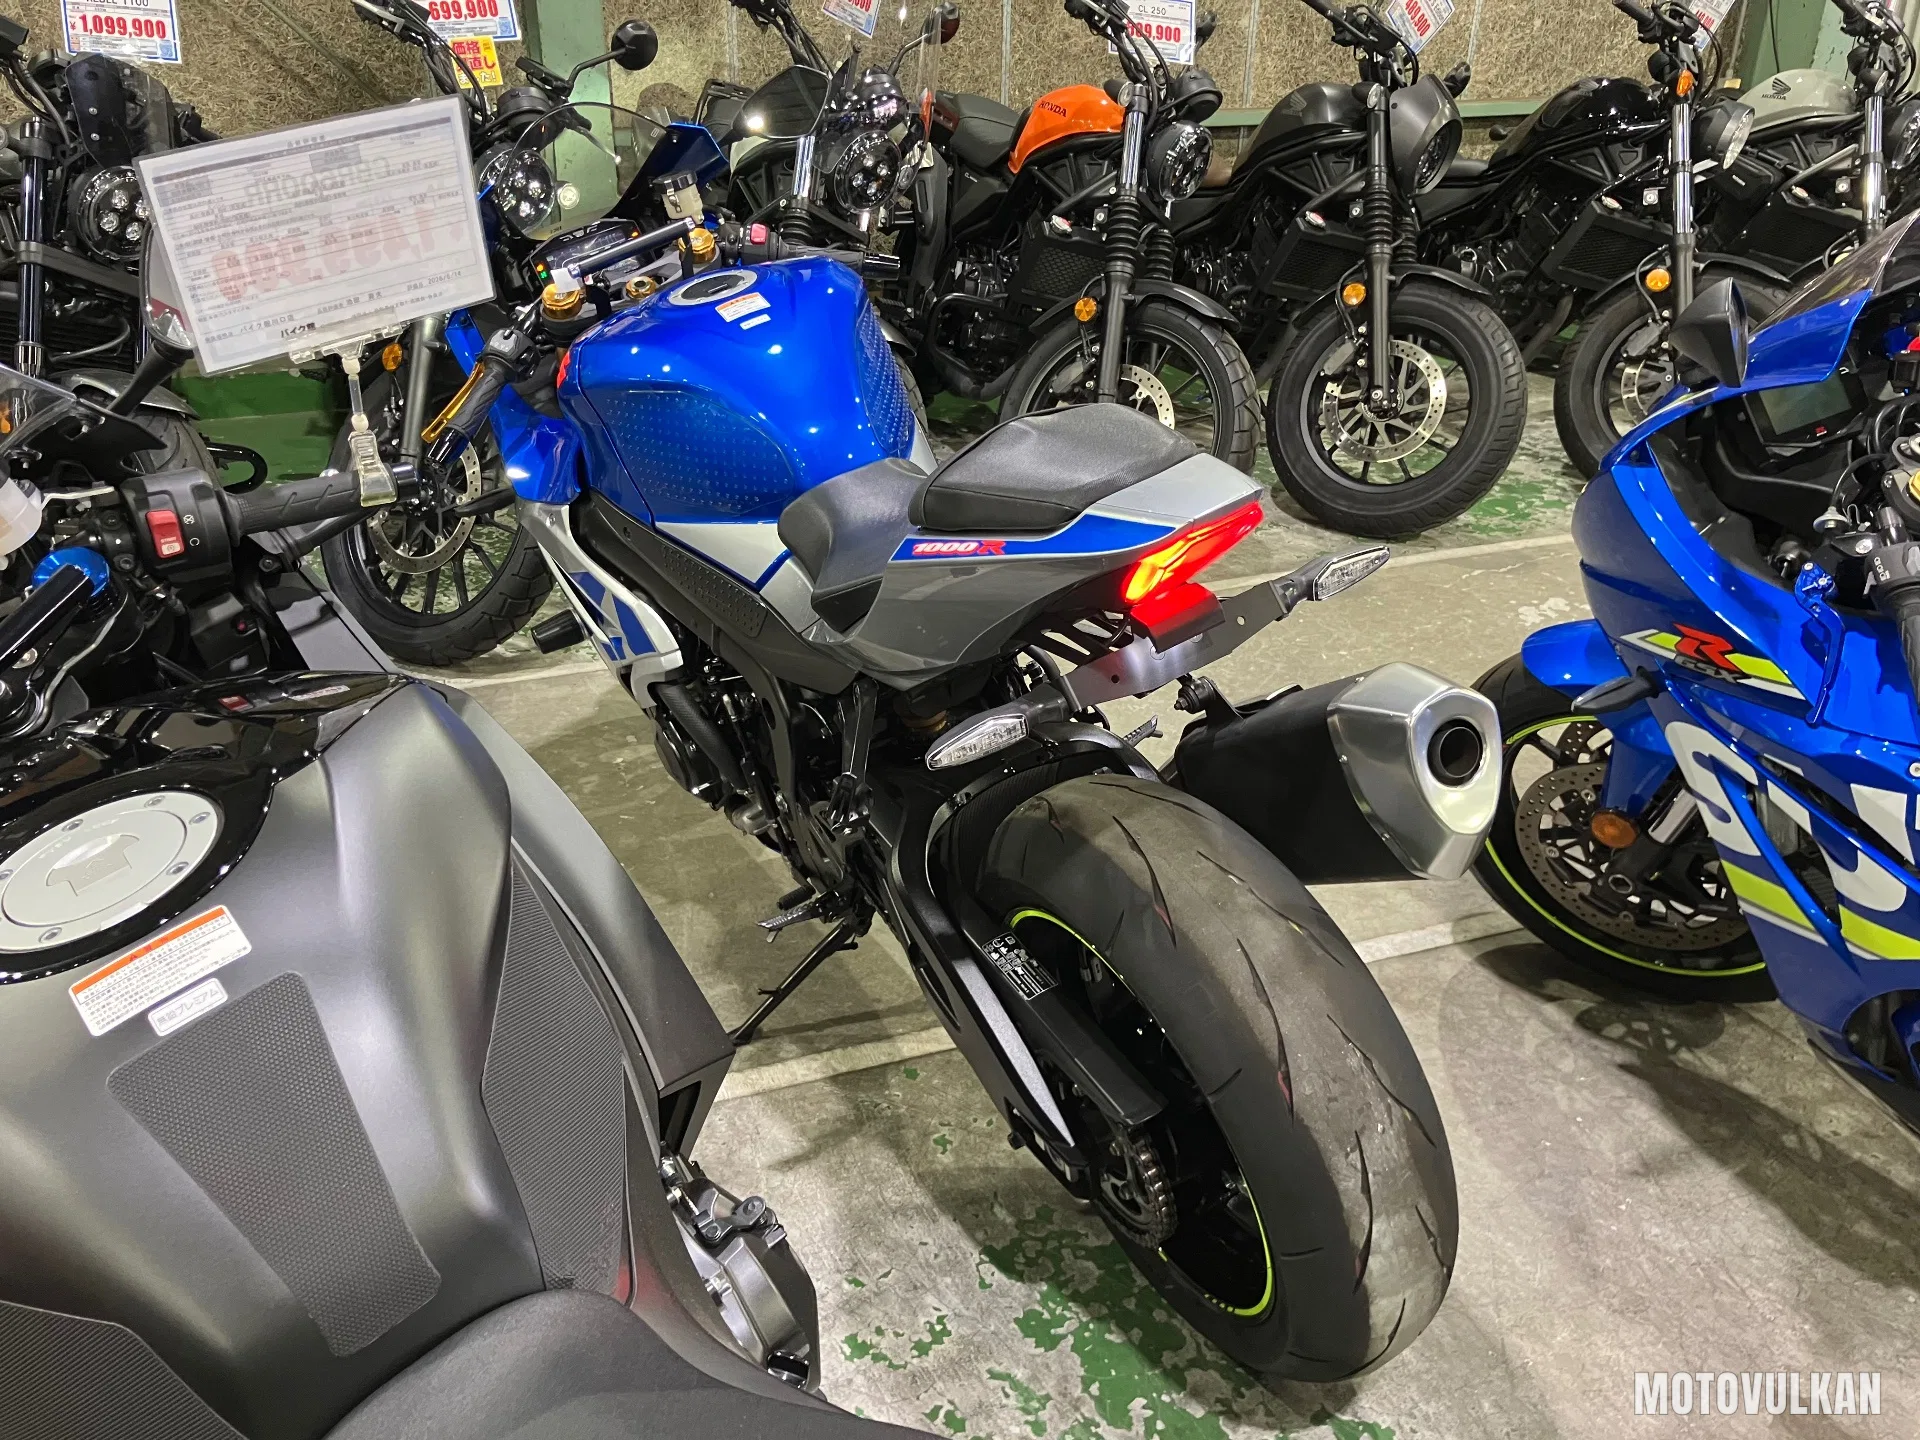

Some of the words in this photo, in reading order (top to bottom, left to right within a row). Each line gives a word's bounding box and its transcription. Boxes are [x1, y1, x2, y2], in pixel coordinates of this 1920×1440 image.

[428, 0, 499, 20] 699,900
[1138, 5, 1148, 13] CL
[1151, 6, 1167, 16] 250
[79, 13, 167, 39] 1,099,900
[453, 40, 480, 55] 価格
[457, 71, 496, 85] また!
[1038, 100, 1067, 118] HONDA
[912, 540, 1006, 557] 1000R
[1674, 653, 1748, 684] GSX
